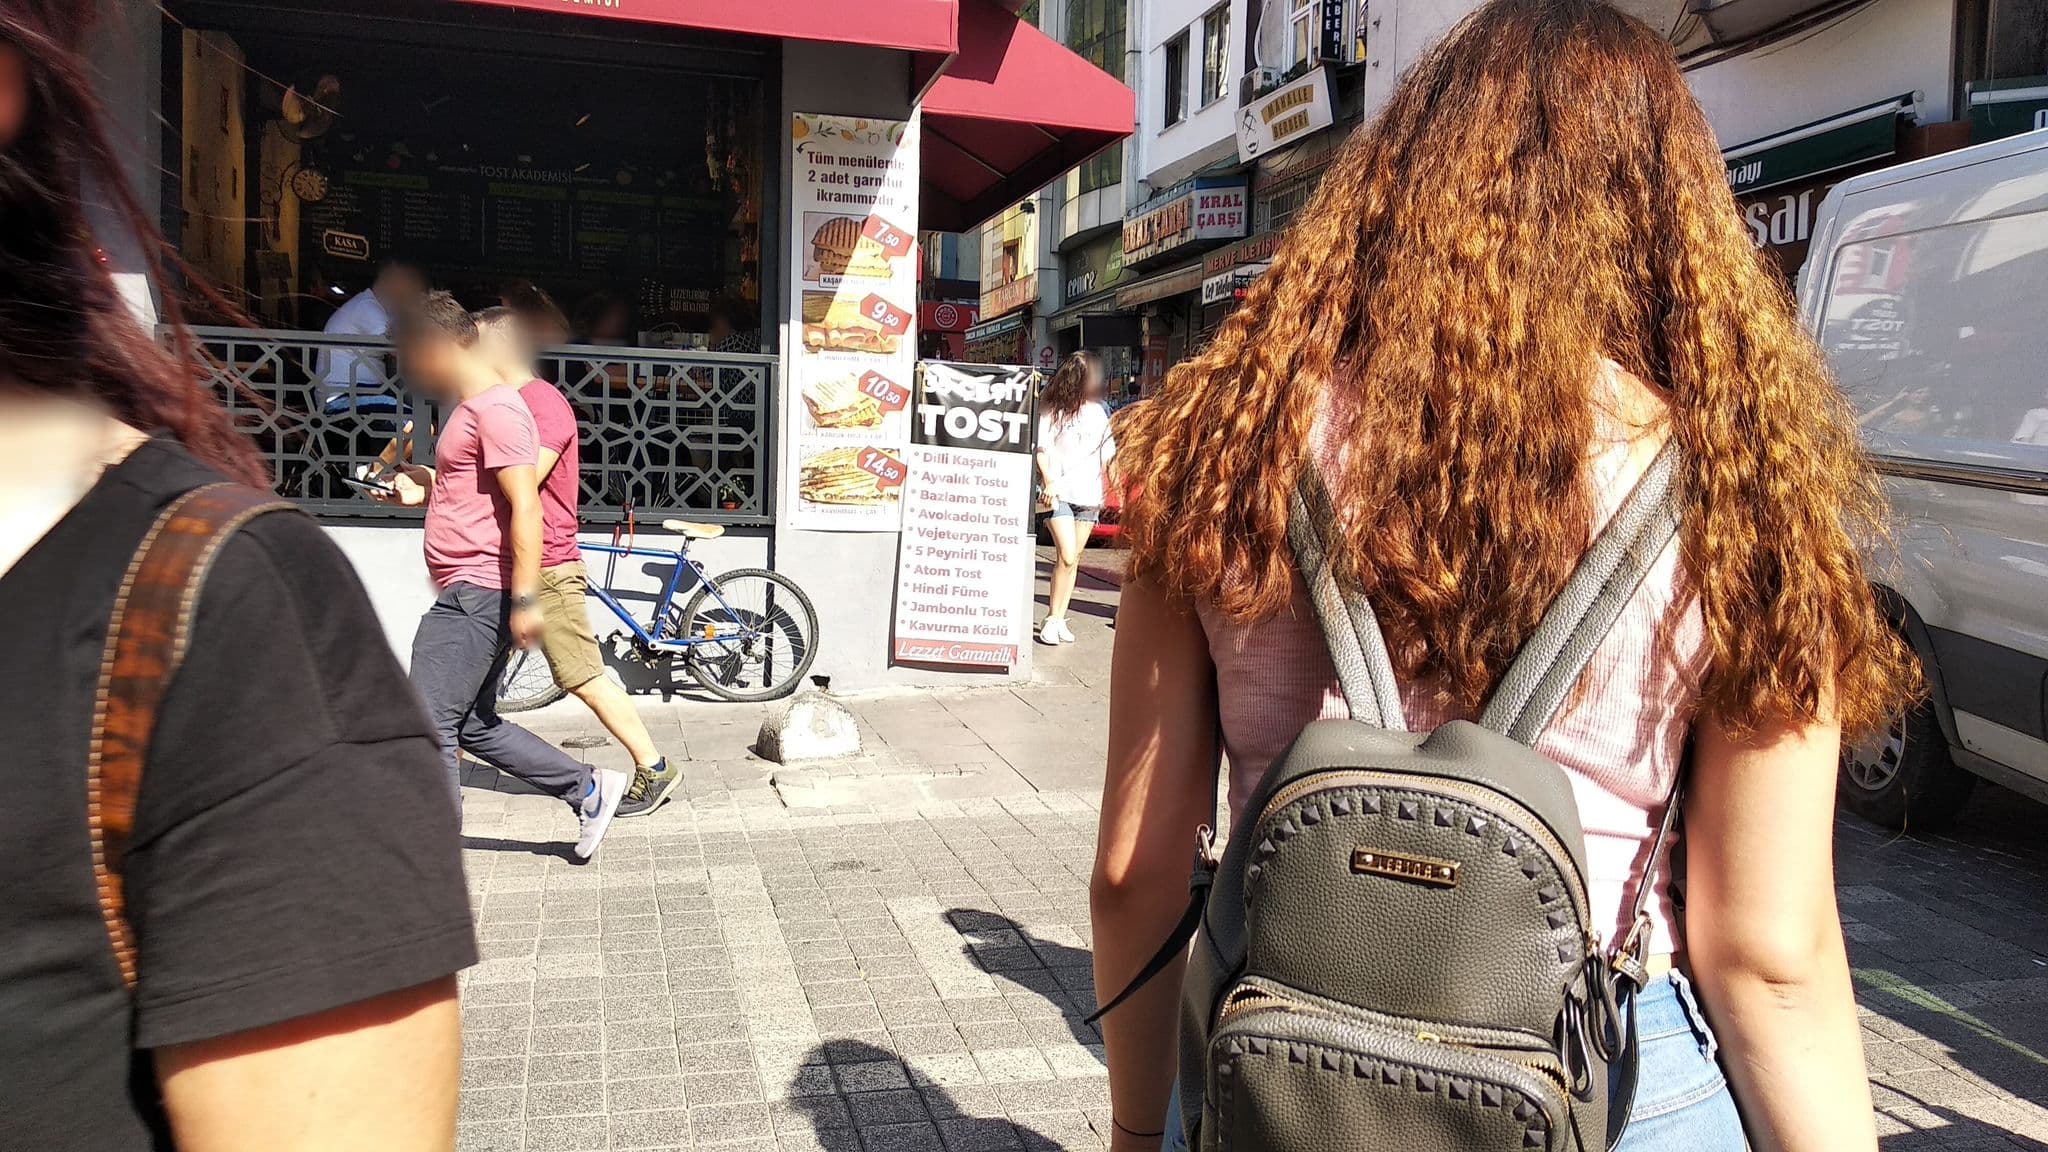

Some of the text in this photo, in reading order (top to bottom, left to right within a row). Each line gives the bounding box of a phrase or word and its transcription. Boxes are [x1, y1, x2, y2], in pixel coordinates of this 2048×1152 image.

[807, 151, 834, 166] Tüm
[807, 169, 816, 183] 2
[820, 171, 850, 185] adet
[1199, 193, 1243, 209] KRAL
[1197, 211, 1243, 230] ÇARŞI
[334, 236, 358, 249] KASA
[917, 403, 1029, 445] TOST
[923, 452, 997, 470] Dilli Kaşarlı
[921, 471, 1009, 488] Ayvalık Tostu
[920, 489, 1008, 507] Bazlama Tost
[918, 508, 1020, 527] Avokadolu Tost
[917, 526, 1019, 545] Vejeteryan Tost
[915, 545, 1008, 562] 5 Peynirli Tost
[913, 564, 983, 579] Atom Tost
[912, 582, 989, 598] Hindi Füme
[910, 601, 1008, 618] Jambonlu Tost
[909, 619, 1009, 636] Kavurma Közlü
[898, 640, 946, 658] Lezzet
